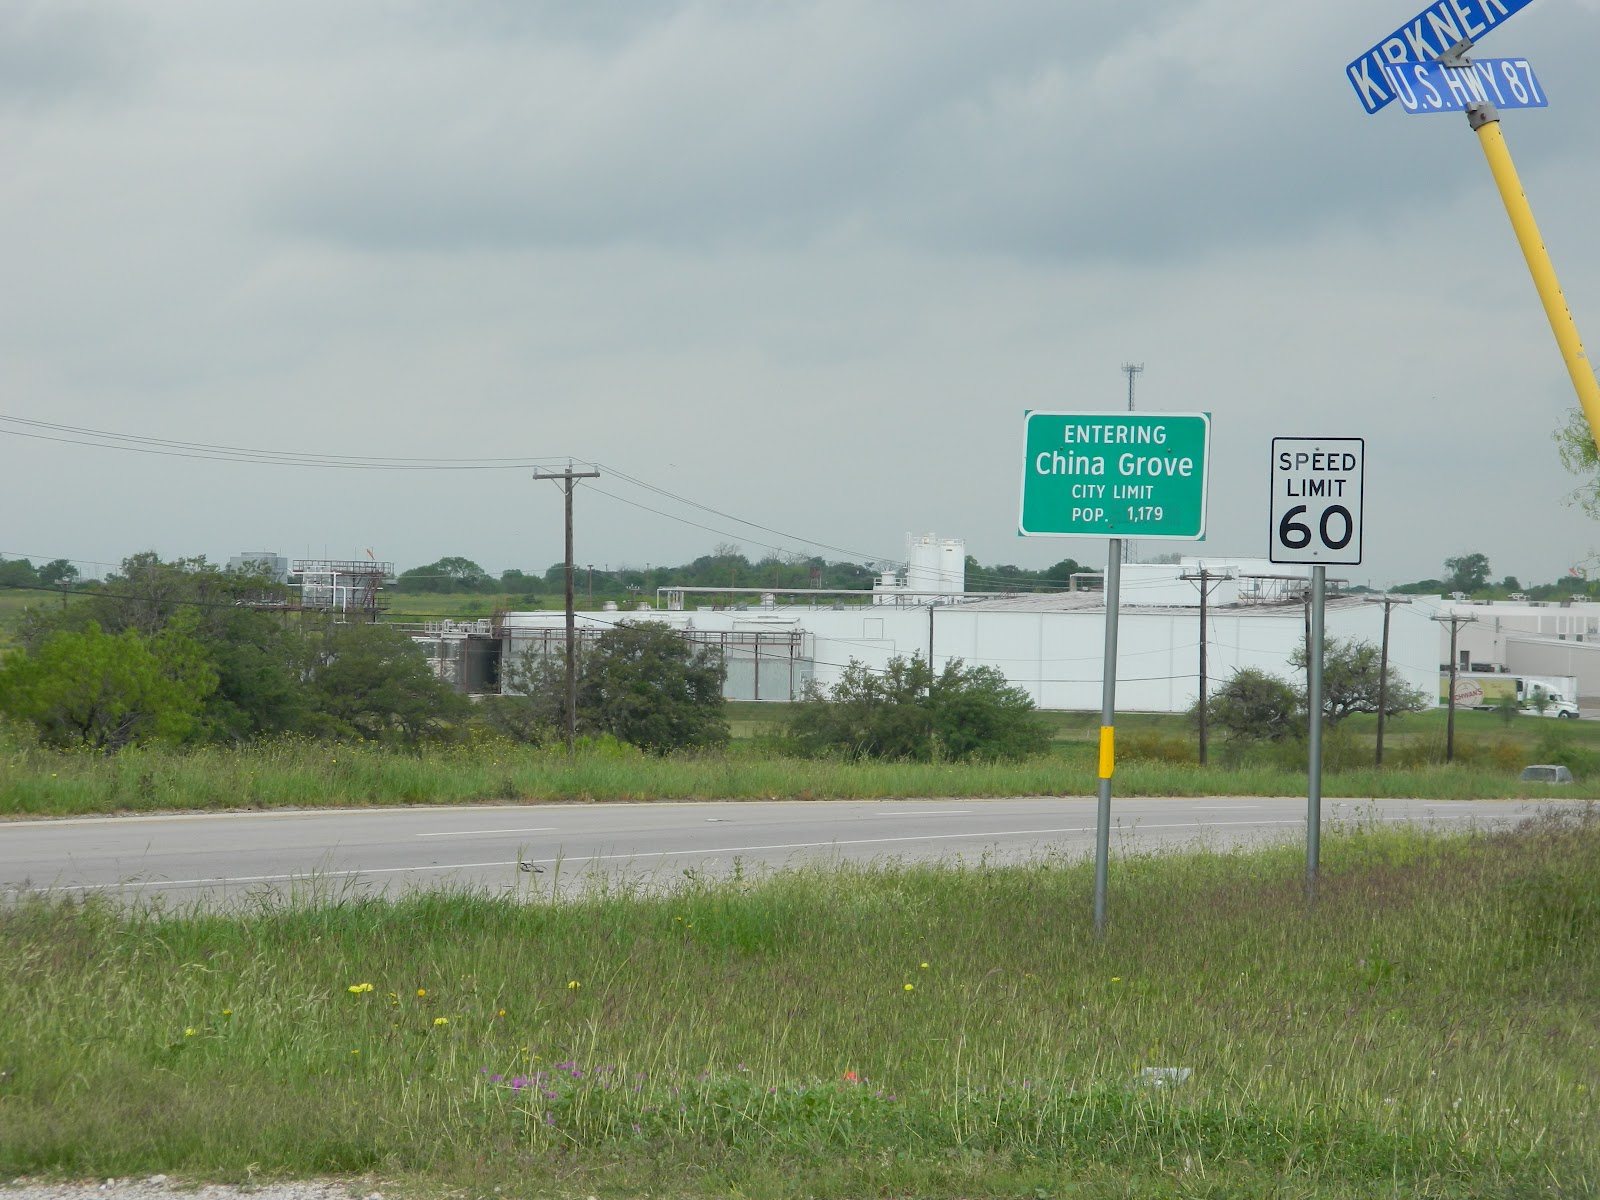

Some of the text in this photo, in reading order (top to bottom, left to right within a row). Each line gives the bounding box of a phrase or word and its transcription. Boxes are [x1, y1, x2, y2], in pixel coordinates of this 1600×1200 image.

[1385, 60, 1541, 110] U.S. HWY 87
[1064, 424, 1167, 445] ENTERING
[1036, 450, 1193, 477] China Grove
[1279, 452, 1356, 471] SPEED
[1071, 484, 1154, 500] CITY LIMIT
[1287, 478, 1347, 497] LIMIT
[1072, 506, 1164, 523] POP. 1,179
[1279, 504, 1353, 550] 60
[1453, 687, 1483, 701] CHWAN'S
